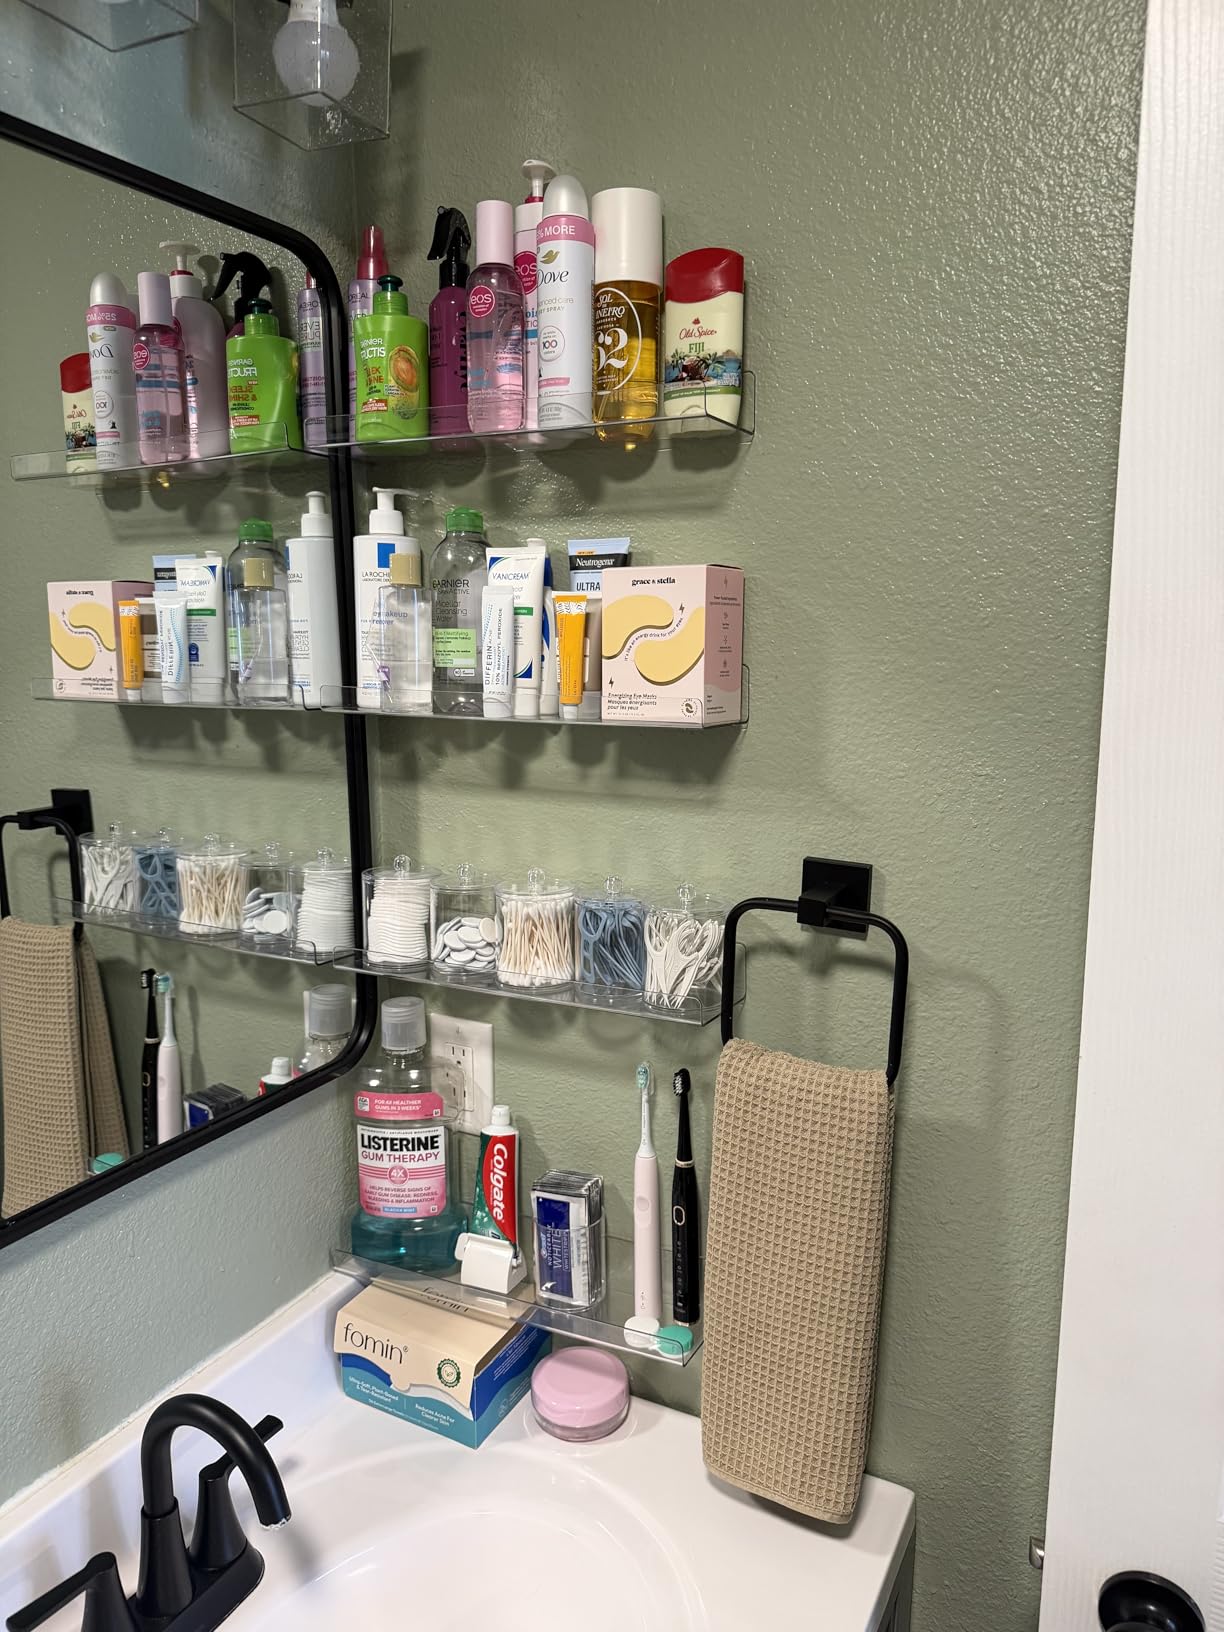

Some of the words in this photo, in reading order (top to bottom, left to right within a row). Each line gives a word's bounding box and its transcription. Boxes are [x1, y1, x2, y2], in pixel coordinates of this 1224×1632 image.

[544, 225, 576, 237] MORE
[470, 293, 492, 305] eos
[595, 305, 626, 319] NEIRO
[678, 327, 694, 341] Old
[693, 325, 717, 340] Spice
[542, 339, 558, 350] 100
[688, 341, 706, 355] FIJI
[575, 557, 615, 568] Neutrogena
[492, 571, 530, 581] VANICREAM
[631, 578, 651, 586] grace
[656, 577, 676, 585] stella
[432, 579, 470, 589] GARNIER
[576, 581, 601, 592] ULTRA
[485, 645, 493, 686] DIFFERIN
[608, 692, 632, 700] Energizing
[360, 1133, 440, 1152] LISTERINE
[361, 1150, 384, 1161] GUM
[386, 1151, 441, 1163] THERAPY
[390, 1169, 405, 1177] 4X
[489, 1143, 508, 1221] Colgate
[551, 1228, 562, 1269] WHITE
[415, 1403, 434, 1415] Reduces
[433, 1411, 447, 1420] Acne
